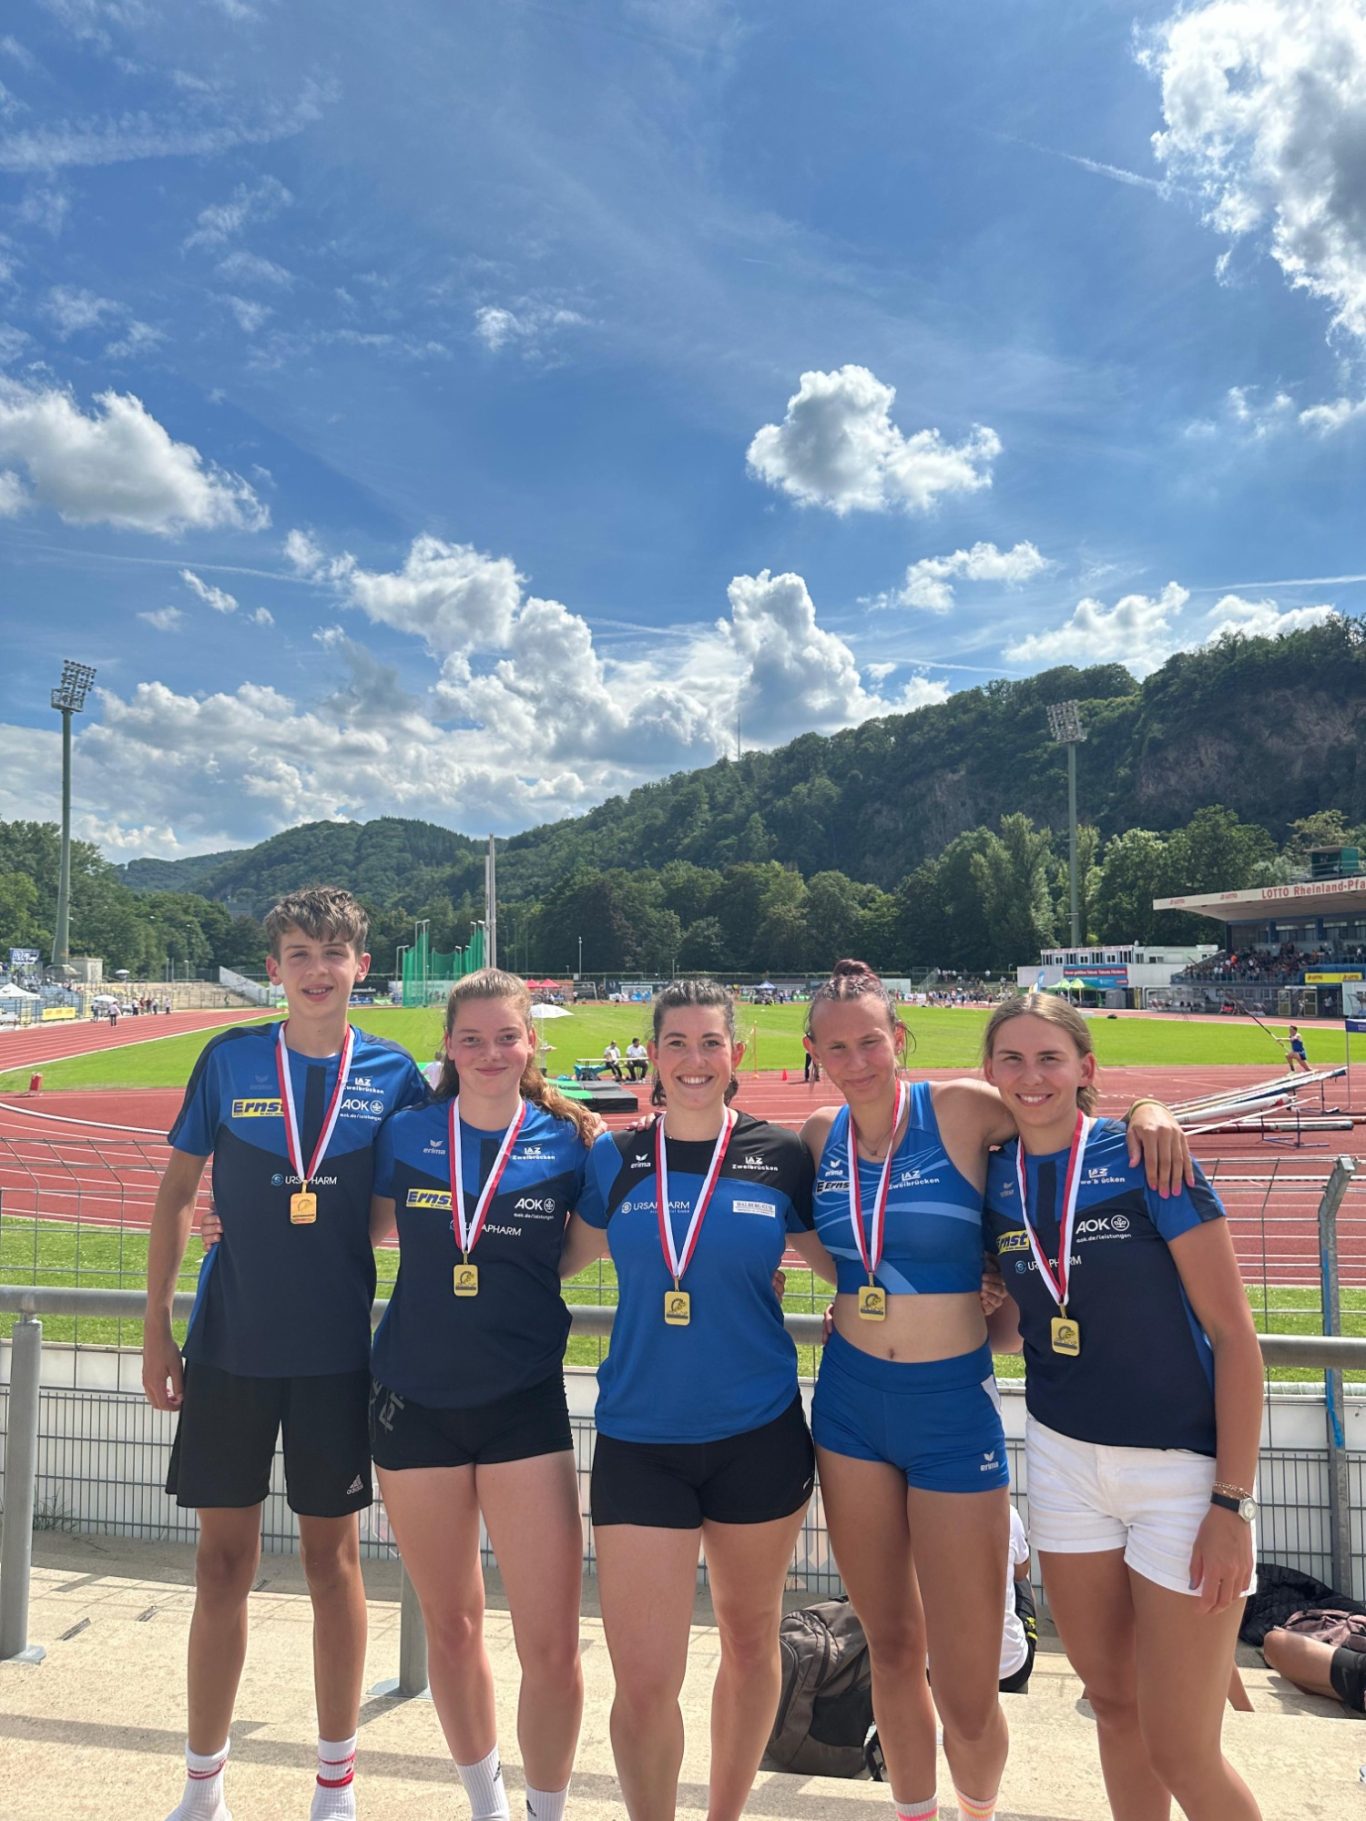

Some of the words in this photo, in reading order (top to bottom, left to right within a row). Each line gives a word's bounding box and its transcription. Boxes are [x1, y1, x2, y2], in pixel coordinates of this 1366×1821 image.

[1262, 888, 1290, 900] LOTTO
[340, 1099, 370, 1112] AOK
[423, 1147, 446, 1156] erima
[630, 1161, 652, 1169] erima
[285, 1175, 338, 1185] URSHARM
[825, 1181, 851, 1190] Erns
[408, 1191, 453, 1206] Erns
[514, 1197, 544, 1211] AOK
[464, 1222, 522, 1237] UAPHARM
[1075, 1218, 1111, 1235] AOK
